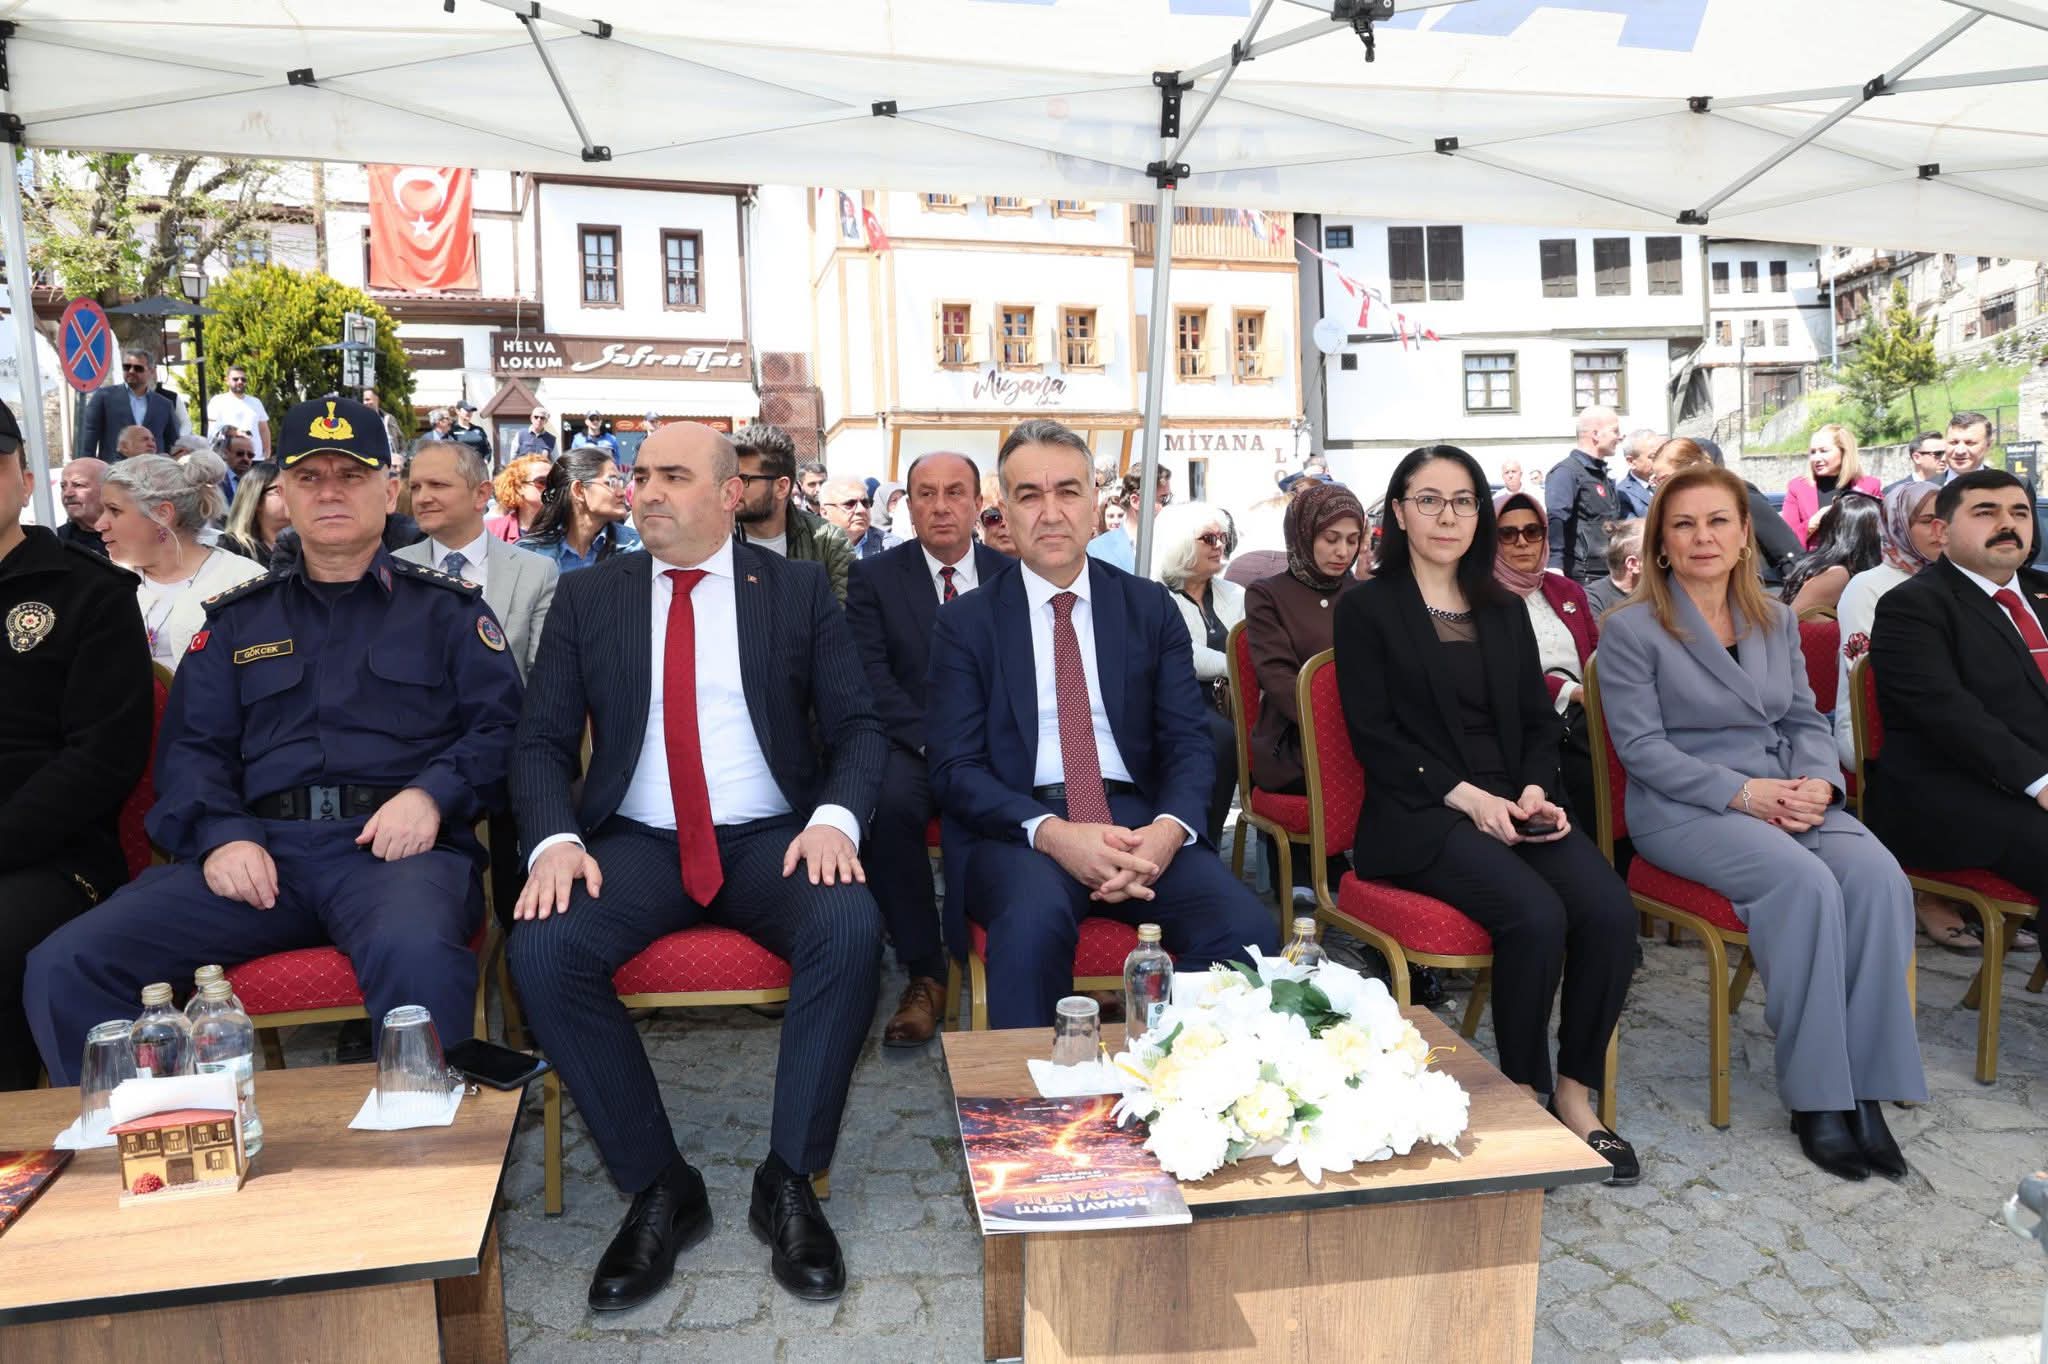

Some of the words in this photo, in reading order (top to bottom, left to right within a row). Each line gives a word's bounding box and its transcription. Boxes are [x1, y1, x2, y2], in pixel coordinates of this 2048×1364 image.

[503, 340, 556, 353] HELVA
[500, 356, 563, 369] LOKUM
[571, 343, 743, 373] SafranTat
[1164, 429, 1265, 451] MİYANA
[1015, 1204, 1074, 1215] KENTİ
